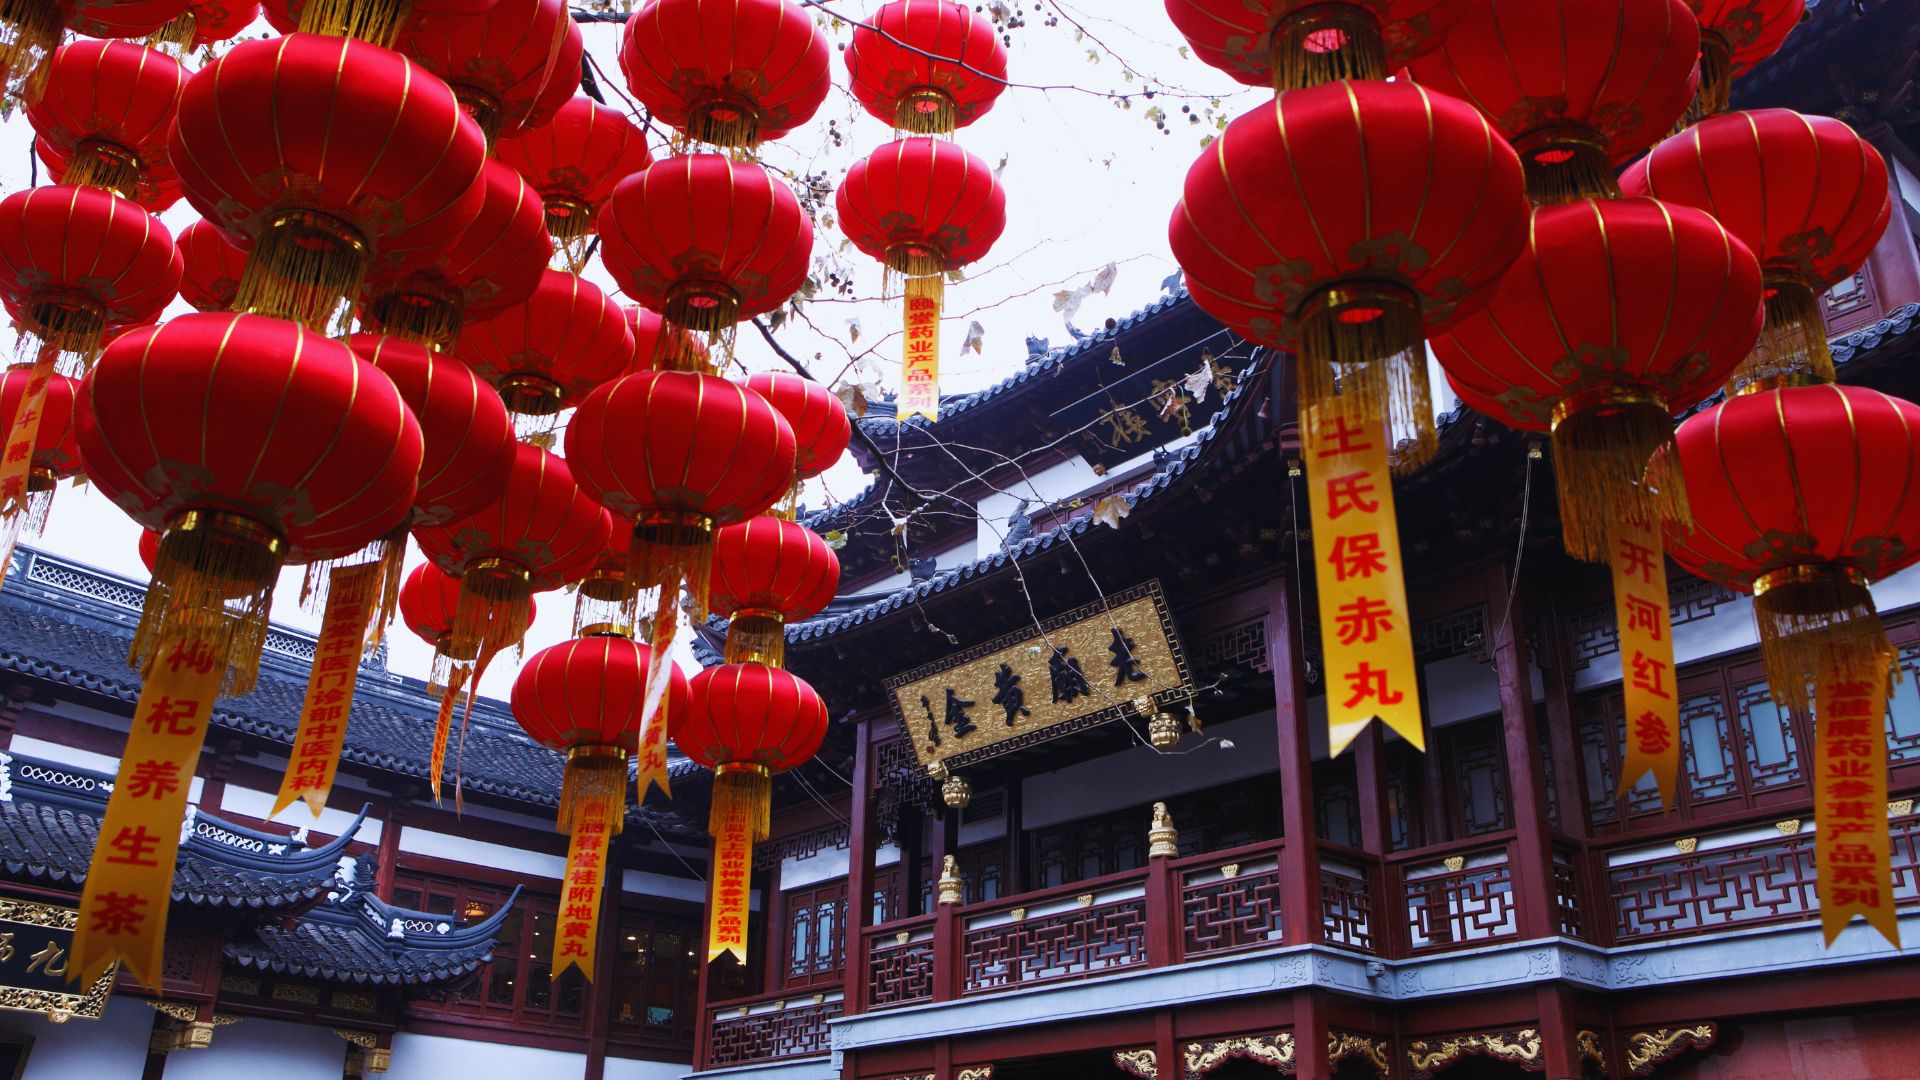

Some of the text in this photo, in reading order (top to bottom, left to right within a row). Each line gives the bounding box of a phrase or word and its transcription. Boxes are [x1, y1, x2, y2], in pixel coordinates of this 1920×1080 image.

[1316, 415, 1404, 708] 王氏保赤丸
[90, 636, 216, 936] 枸杞养生茶
